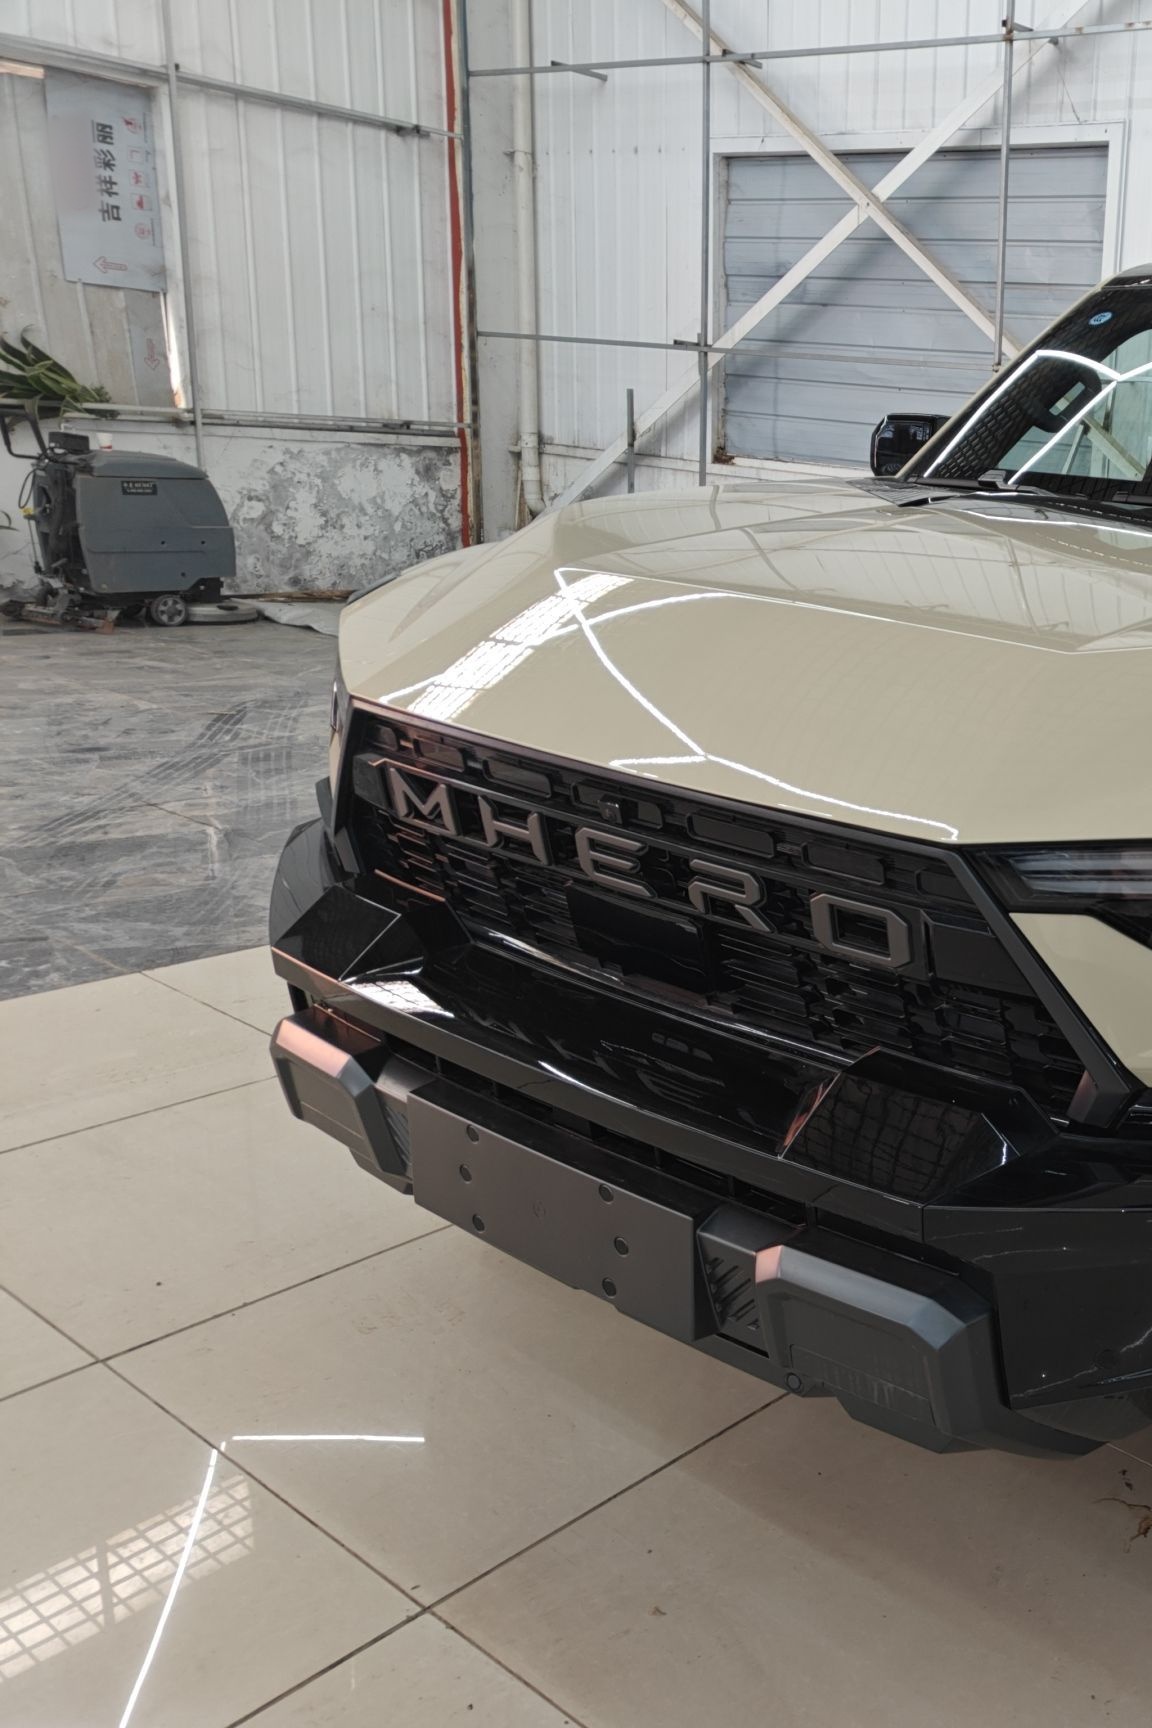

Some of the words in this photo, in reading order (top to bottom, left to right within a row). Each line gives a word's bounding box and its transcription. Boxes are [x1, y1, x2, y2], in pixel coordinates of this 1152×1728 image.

[91, 119, 122, 222] 吉祥彩丽
[389, 767, 911, 968] MHERO
